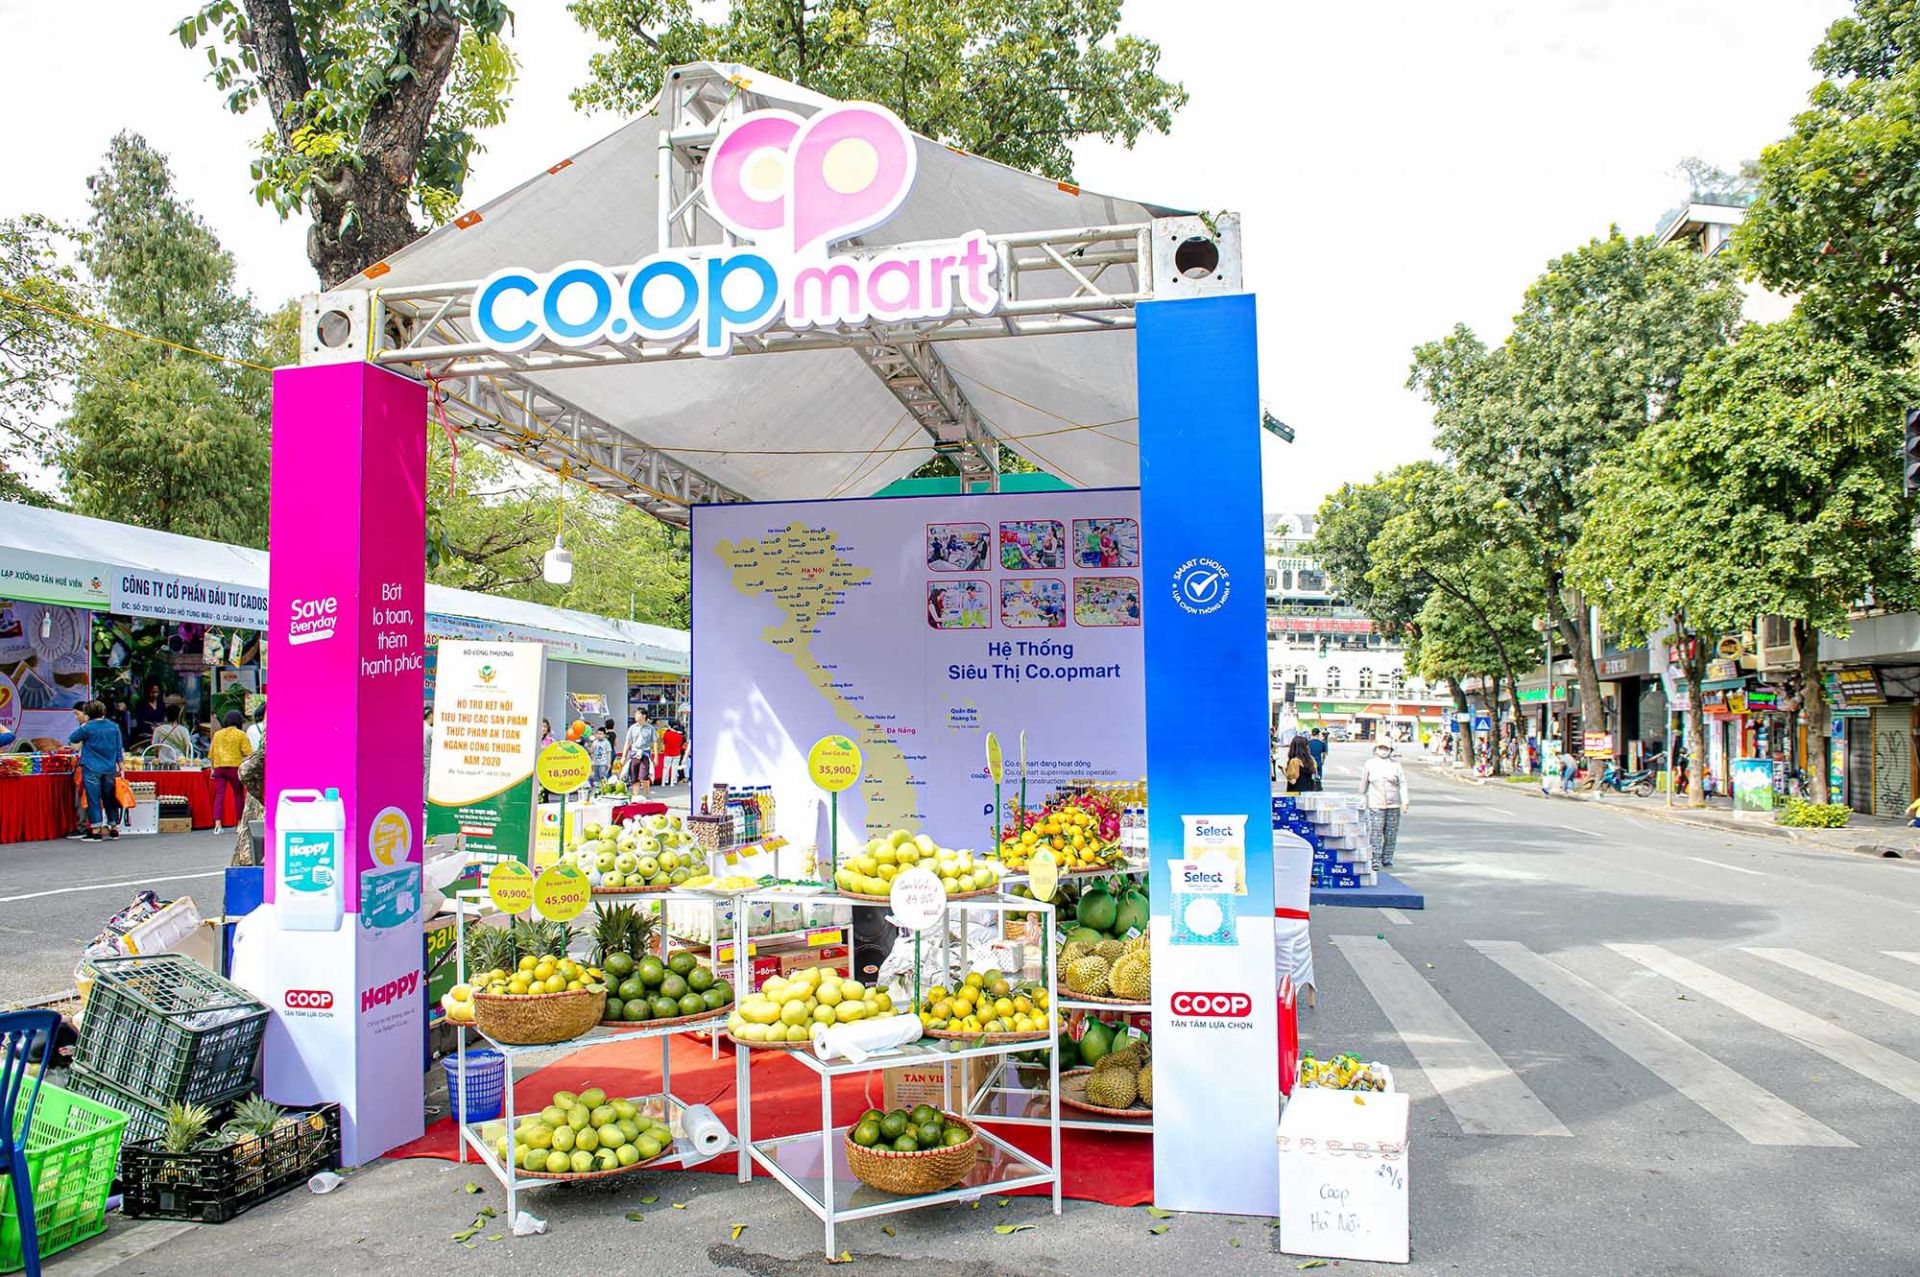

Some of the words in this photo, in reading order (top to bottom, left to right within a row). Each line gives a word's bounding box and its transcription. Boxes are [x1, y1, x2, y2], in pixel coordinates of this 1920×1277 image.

[1173, 559, 1198, 581] SMART
[1199, 558, 1230, 580] CHOICE
[1278, 559, 1307, 570] COFFEE
[122, 574, 150, 596] CÔNG
[152, 581, 164, 597] TY
[228, 592, 239, 607] TƯ
[382, 583, 403, 601] Bớt
[290, 596, 337, 620] Save
[372, 607, 384, 625] lo
[385, 608, 414, 626] toan,
[290, 616, 337, 634] Everyday
[377, 631, 408, 650] thêm
[988, 641, 1012, 660] Hệ
[1016, 639, 1074, 659] Thống
[361, 654, 392, 678] hạnh
[394, 652, 423, 677] phúc
[948, 665, 987, 680] Siêu
[992, 664, 1020, 683] Thị
[1025, 663, 1121, 682] Co.opmart
[481, 755, 501, 767] 2020
[1040, 760, 1056, 768] đang
[1074, 760, 1091, 768] động
[547, 768, 580, 778] 18,900
[819, 765, 851, 775] 35,900
[1040, 769, 1085, 777] supermarkets
[1086, 769, 1117, 777] operation
[1196, 826, 1233, 837] Select
[289, 841, 330, 857] Happy
[1184, 871, 1223, 883] Select
[375, 880, 396, 896] Happy
[497, 889, 526, 898] 49,900
[544, 893, 579, 905] 45,900
[361, 969, 420, 1013] Happy
[286, 992, 332, 1007] COOP
[1173, 994, 1249, 1015] COOP
[1208, 1021, 1226, 1029] LỰA
[1227, 1022, 1253, 1031] CHỌN
